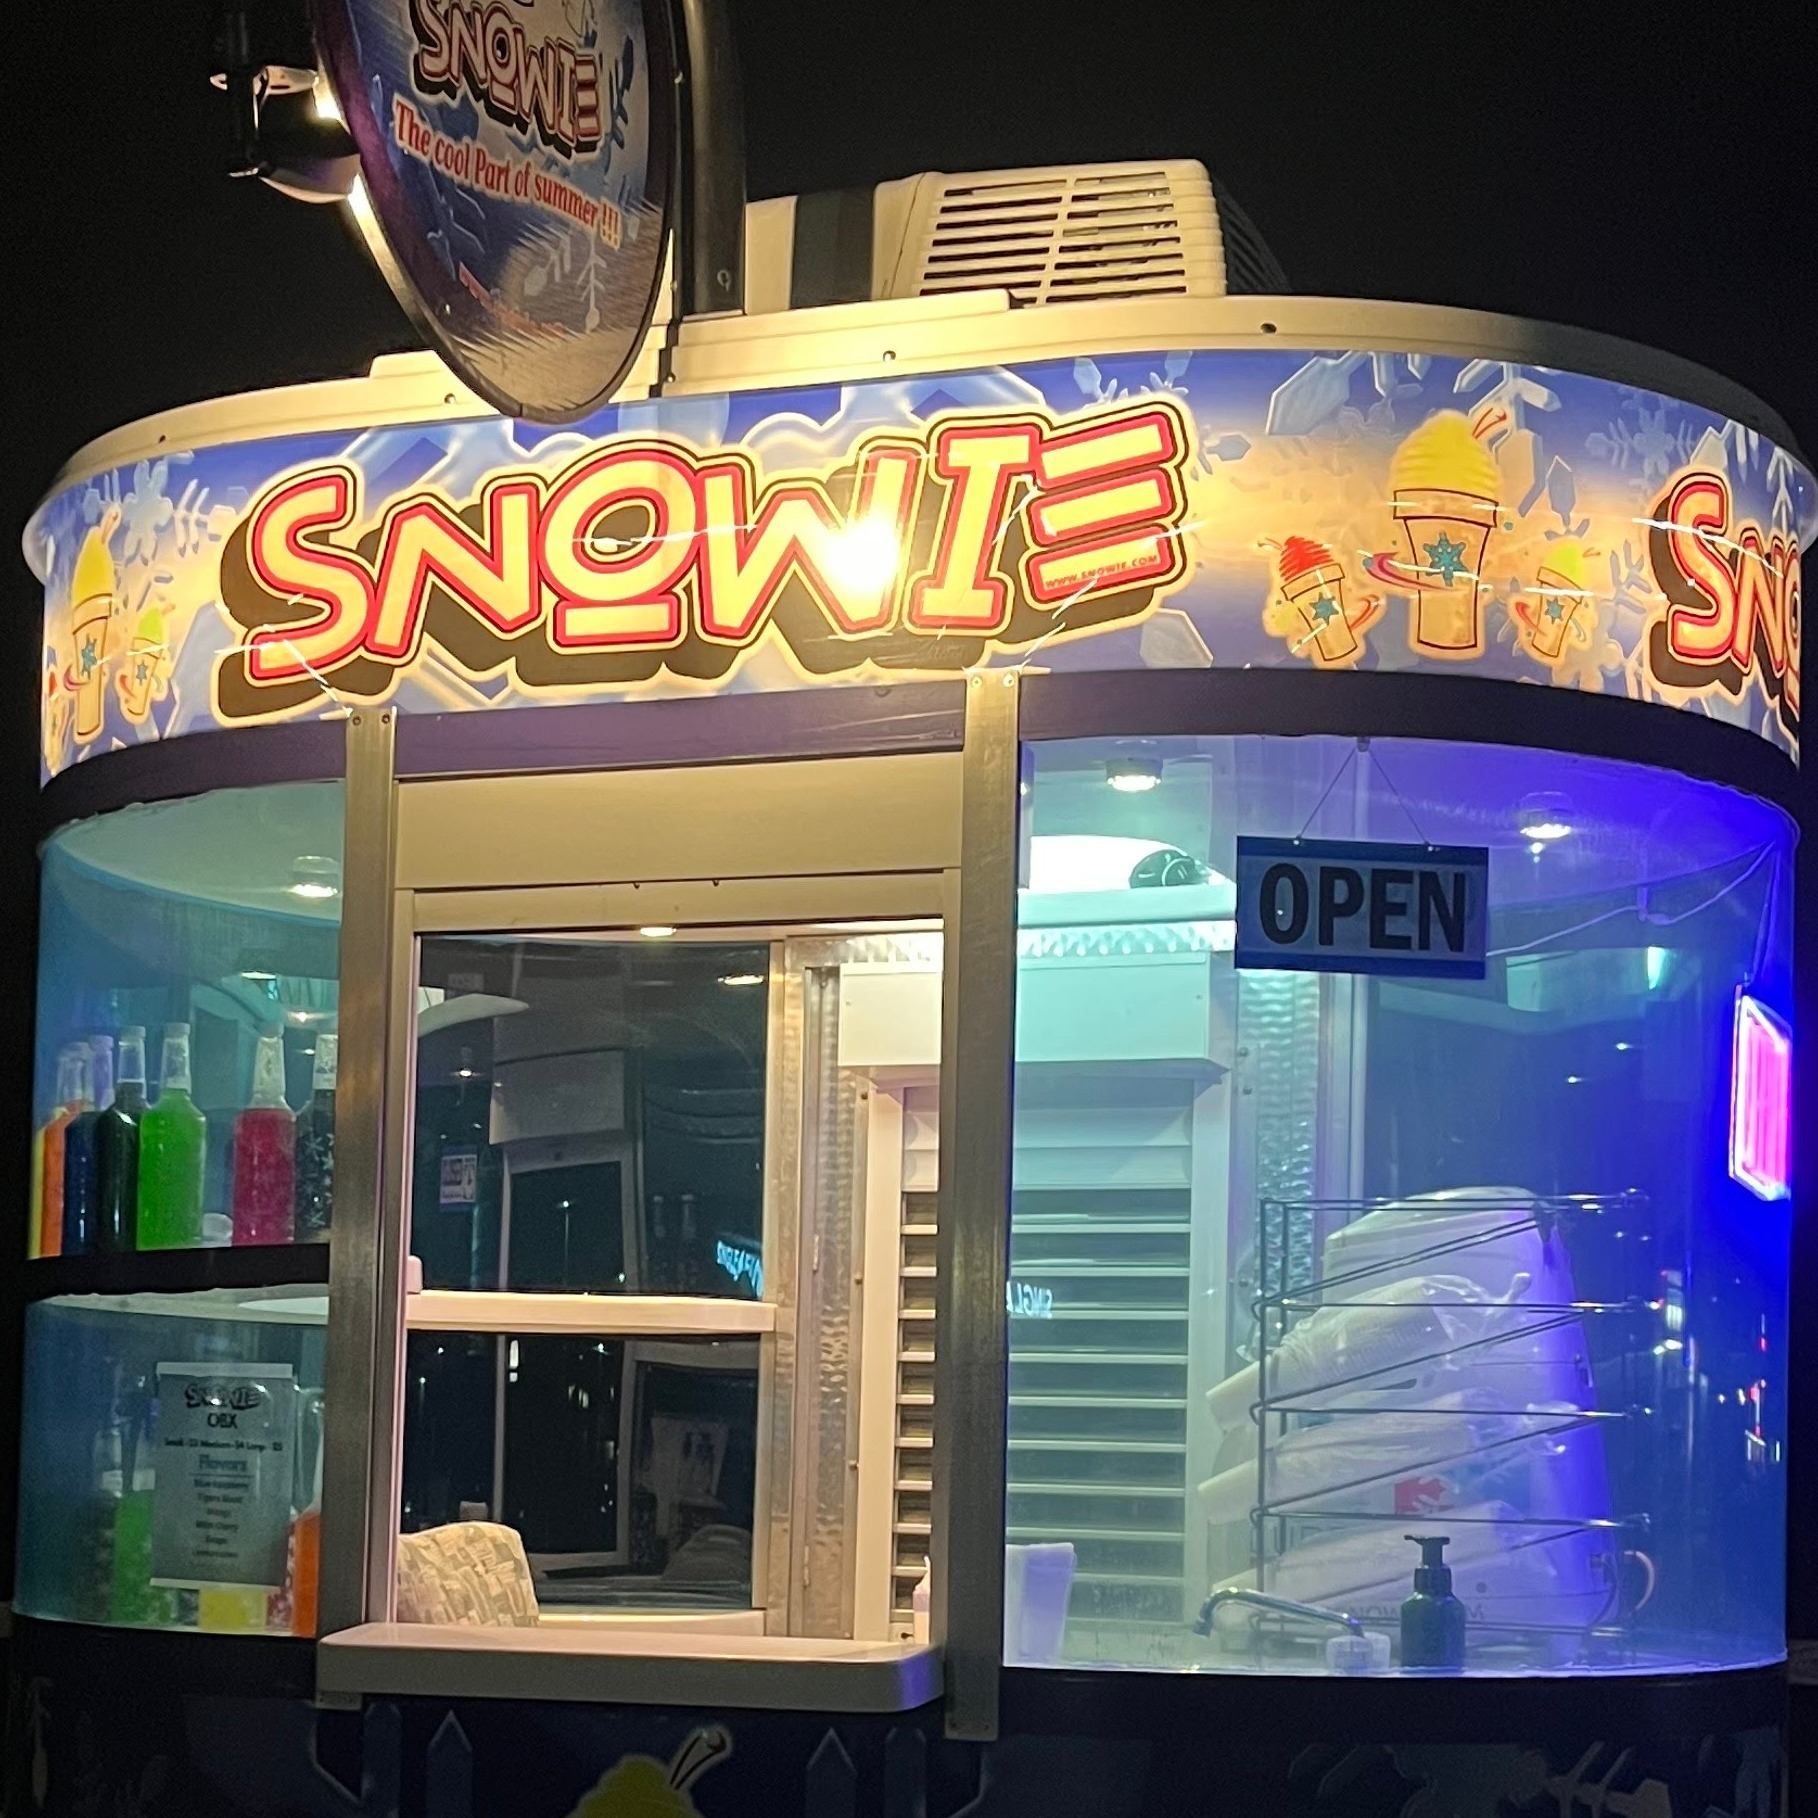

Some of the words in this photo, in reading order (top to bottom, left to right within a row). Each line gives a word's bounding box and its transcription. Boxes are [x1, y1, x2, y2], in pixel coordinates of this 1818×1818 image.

[414, 0, 600, 146] SNOWIE
[396, 100, 431, 157] The
[435, 139, 470, 180] cool
[475, 148, 510, 194] Part
[514, 161, 532, 197] of
[246, 408, 1182, 682] SNOWIE
[1045, 555, 1158, 588] WWW.SNOWIE.COM
[1259, 862, 1467, 952] OPEN
